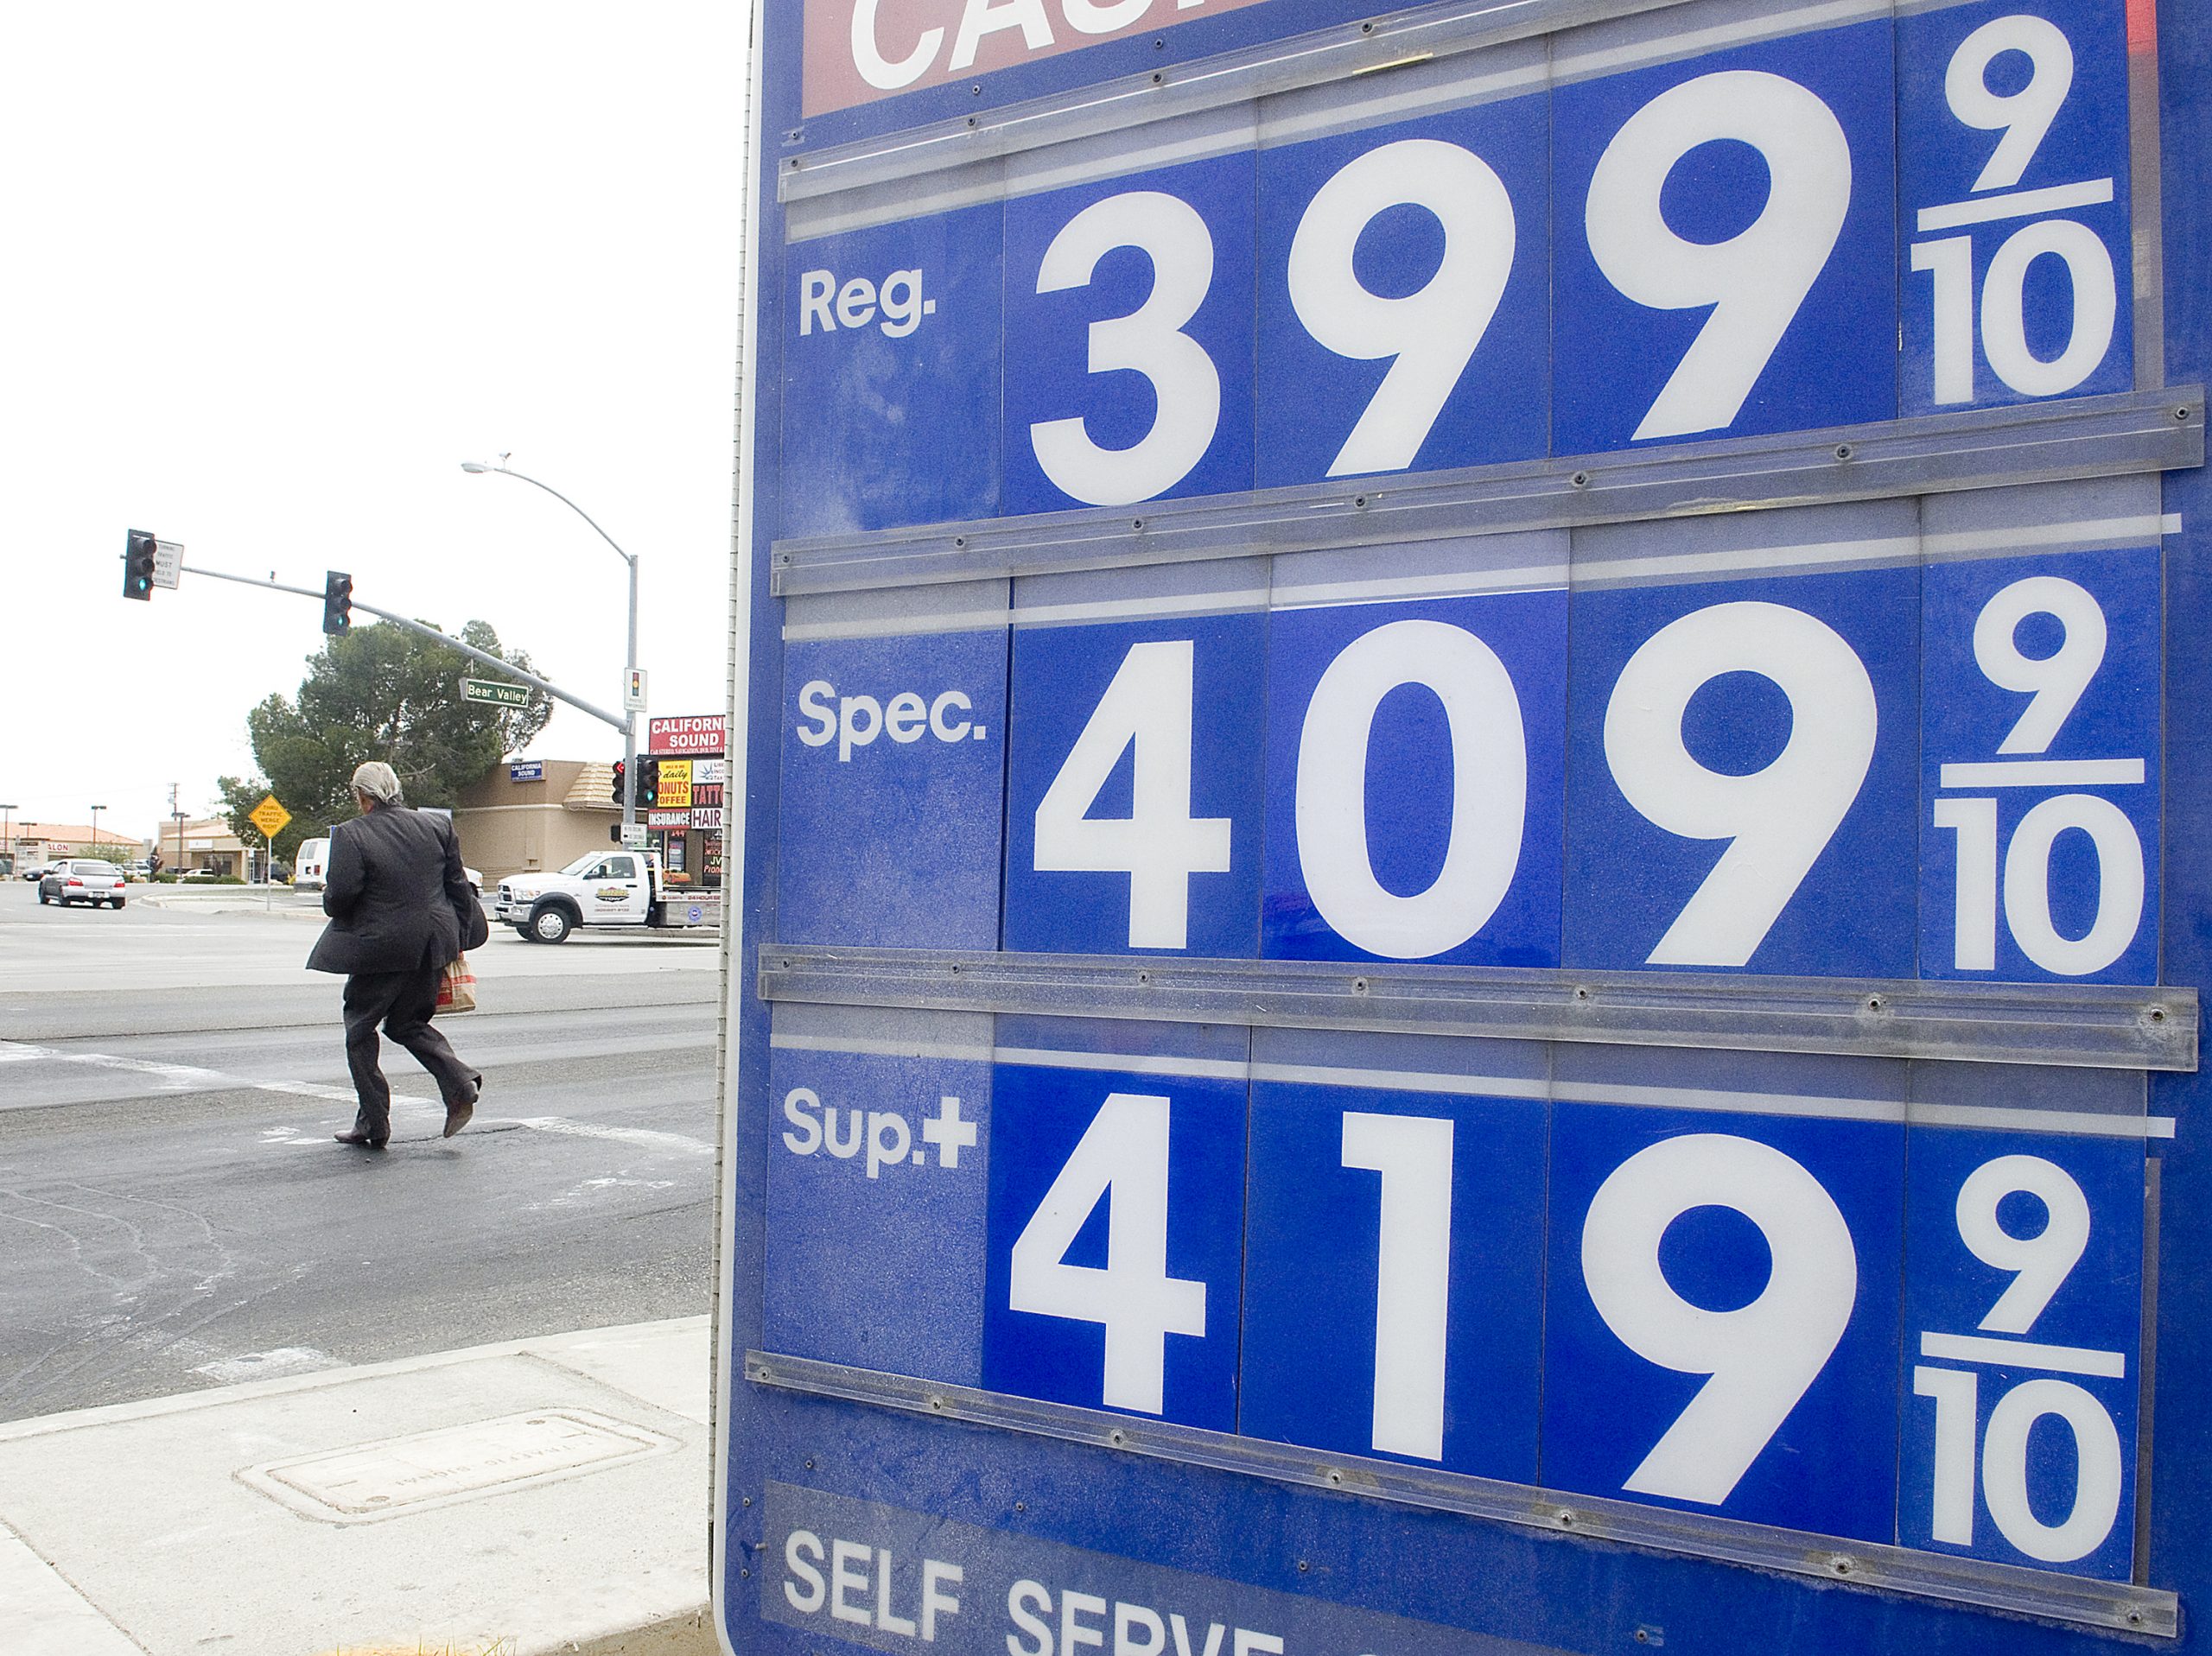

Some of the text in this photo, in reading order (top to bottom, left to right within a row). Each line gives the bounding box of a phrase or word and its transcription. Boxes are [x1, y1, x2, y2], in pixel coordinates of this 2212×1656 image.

[1945, 15, 2074, 193] 9
[799, 268, 937, 339] Reg.
[1910, 219, 2117, 405] 10
[467, 684, 528, 704] Bear Valley
[1974, 576, 2107, 755] 9
[669, 733, 720, 748] SOUND
[796, 679, 988, 764] Spec.
[512, 763, 542, 771] CALIFORNIA
[658, 796, 686, 804] OFFEE
[663, 769, 689, 780] daily
[649, 812, 690, 826] INSURANCE
[693, 809, 721, 827] HAIR
[1934, 794, 2145, 976] 10
[1956, 1154, 2091, 1335] 9
[1913, 1366, 2122, 1563] 10
[784, 1531, 963, 1643] SELF
